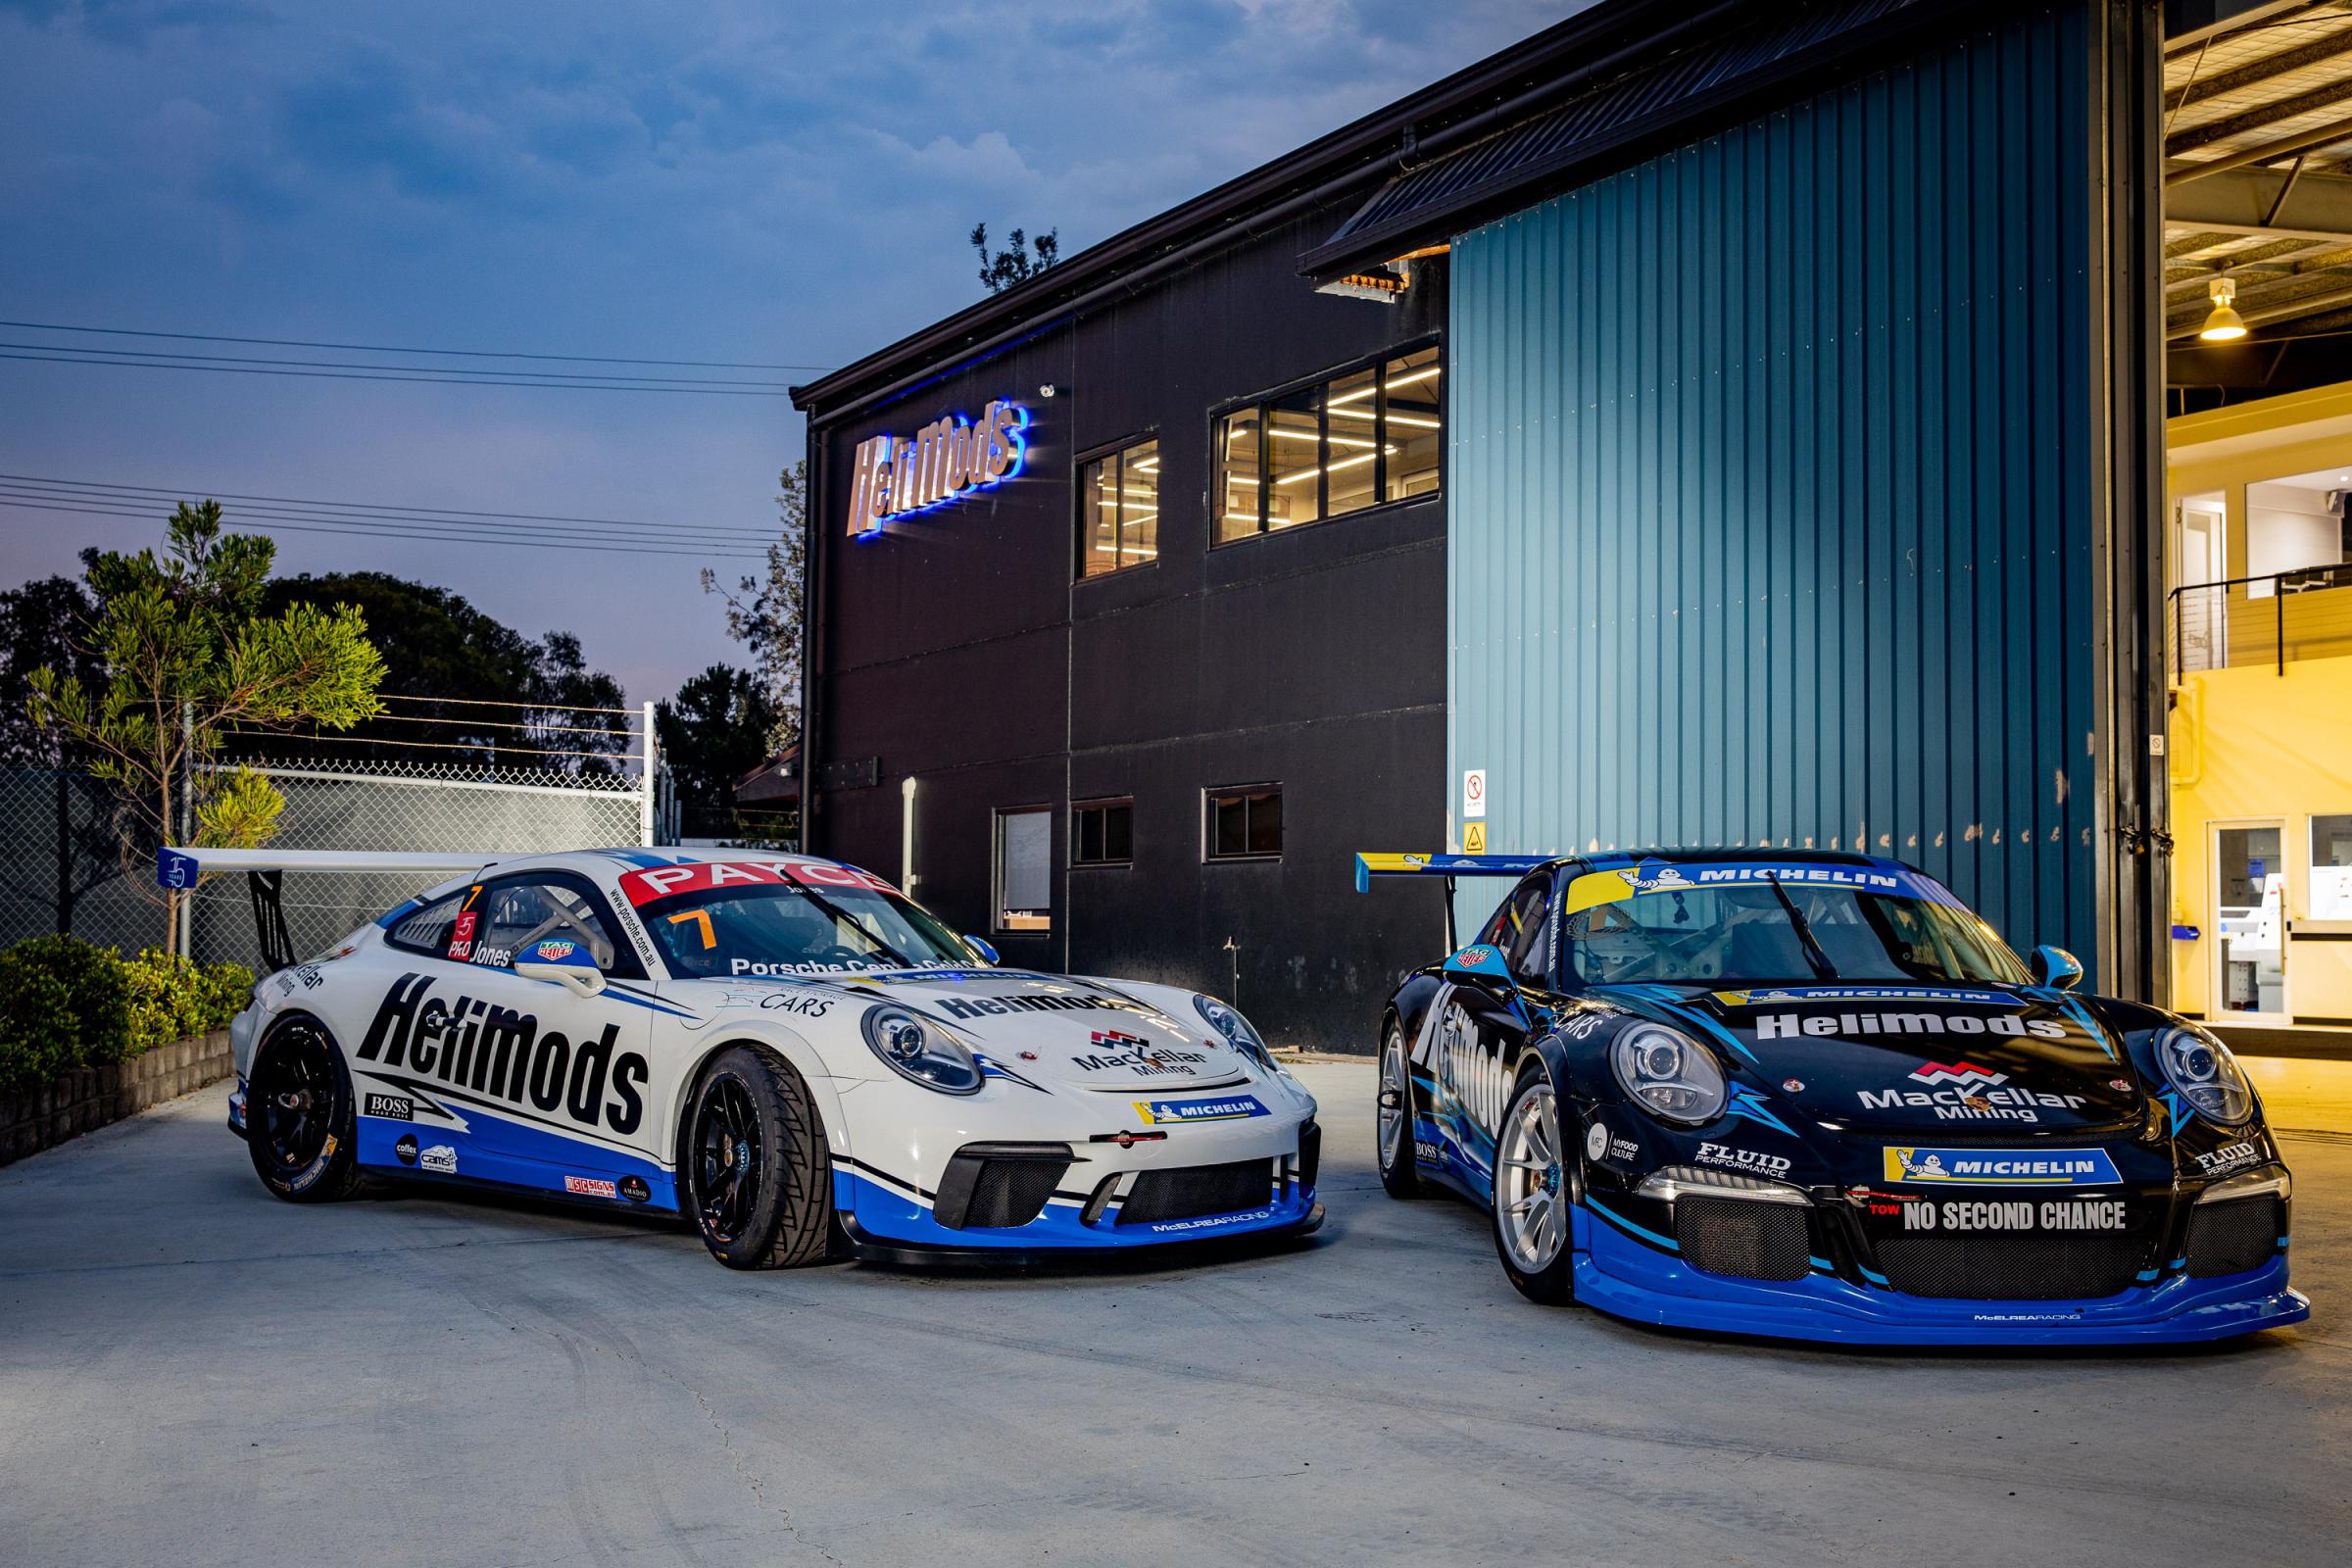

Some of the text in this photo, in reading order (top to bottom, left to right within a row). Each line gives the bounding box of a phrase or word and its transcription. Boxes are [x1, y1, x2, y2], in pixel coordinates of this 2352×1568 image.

[1699, 869, 1897, 887] MICHELIN
[463, 885, 483, 912] 7
[610, 888, 657, 967] www.porsche.com.au
[667, 908, 717, 951] 7
[448, 941, 471, 957] PRO
[469, 941, 512, 967] Jones
[539, 948, 572, 960] HEUER
[730, 957, 844, 976] Porsche
[1457, 955, 1486, 967] HEUER
[1807, 989, 1991, 1000] MICHELIN
[760, 994, 835, 1017] CARS
[1756, 1011, 2067, 1039] Helimods
[356, 971, 649, 1135] Helimods
[1071, 1046, 1207, 1071] MacKellar
[1130, 1064, 1198, 1077] Mining
[371, 1096, 410, 1114] BOSS
[1856, 1082, 2086, 1110] MacKellar
[1180, 1101, 1256, 1117] MICHELIN
[1934, 1105, 2038, 1122] Mining
[397, 1144, 417, 1154] coffex
[1416, 1142, 1437, 1158] BOSS
[1610, 1147, 1636, 1161] CULTURE
[1697, 1142, 1791, 1170] FLUID
[2195, 1143, 2255, 1169] FLUID
[1694, 1154, 1787, 1179] PERFORMANCE
[1954, 1160, 2095, 1174] MICHELIN
[2205, 1153, 2262, 1176] PERFORMANCE
[1869, 1204, 1900, 1215] TOW
[1904, 1201, 2126, 1230] NO SECOND CHANCE
